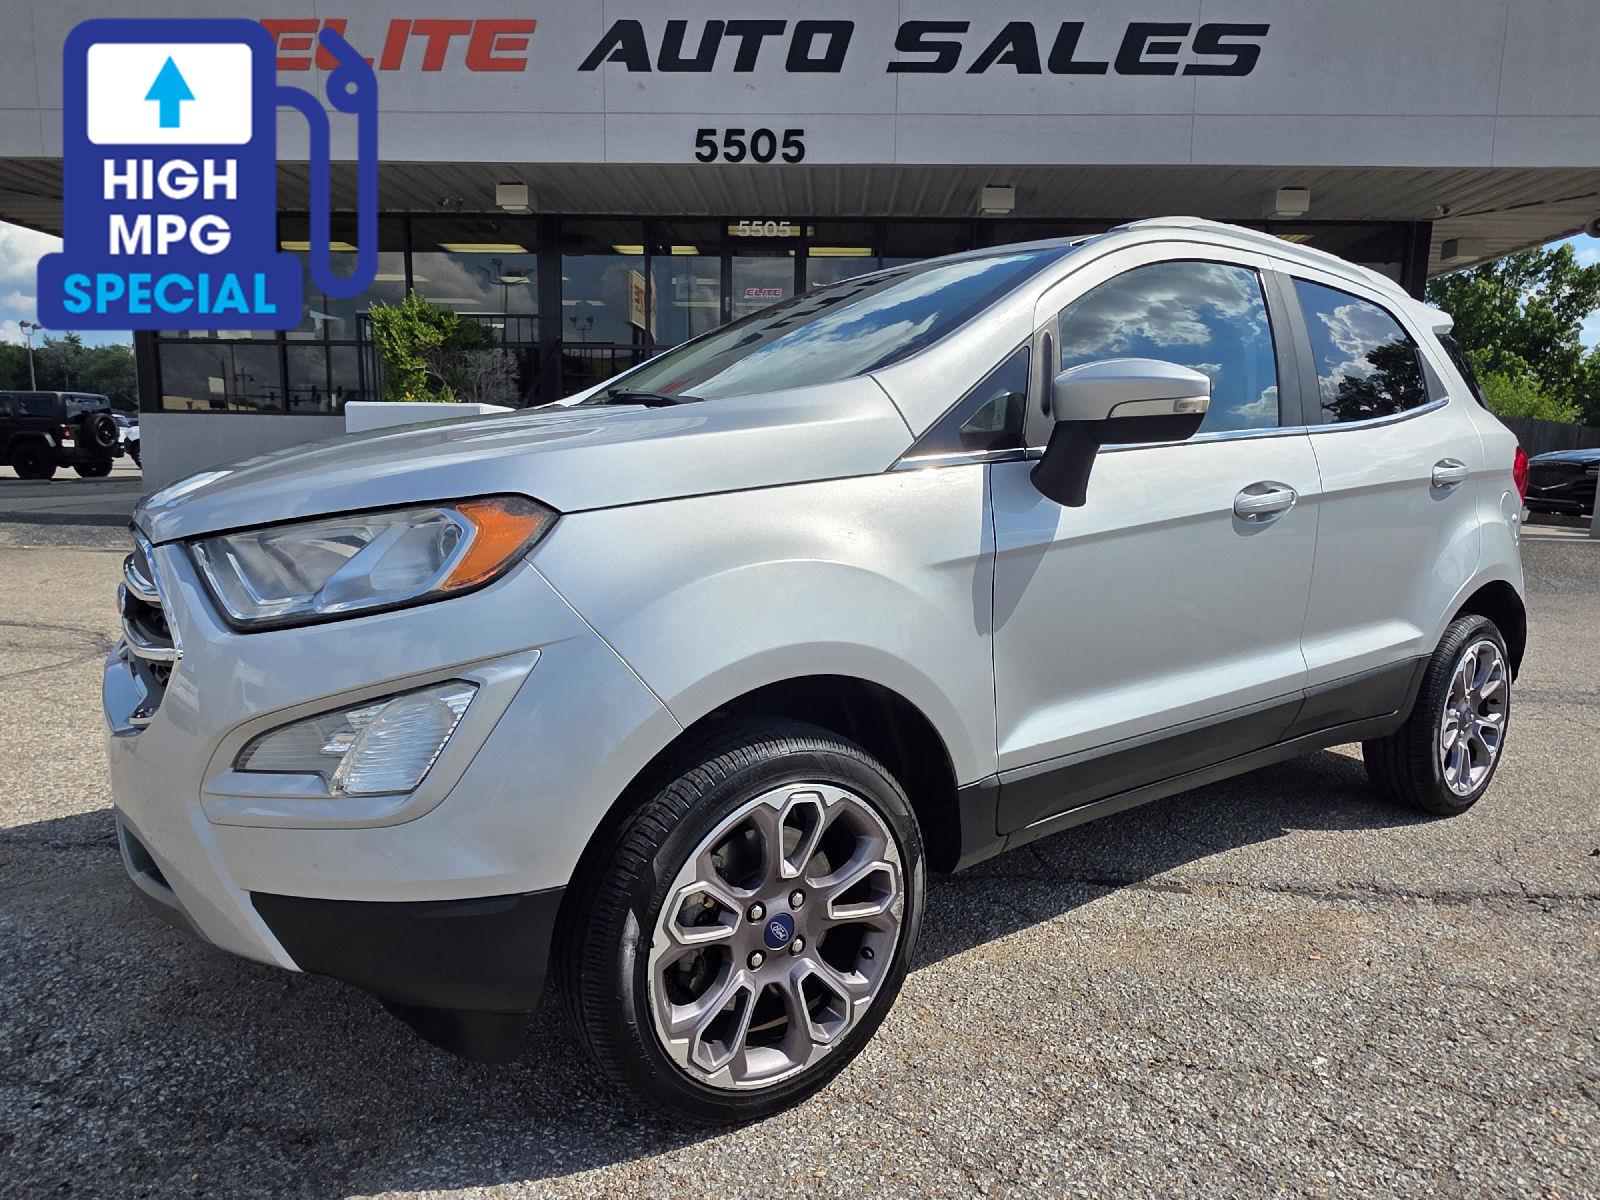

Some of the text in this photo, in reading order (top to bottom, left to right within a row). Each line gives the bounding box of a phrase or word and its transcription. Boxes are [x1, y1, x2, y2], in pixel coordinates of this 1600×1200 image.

[578, 19, 855, 73] AUTO
[886, 21, 1271, 77] SALES
[694, 128, 806, 163] 5505
[738, 220, 791, 237] 5505
